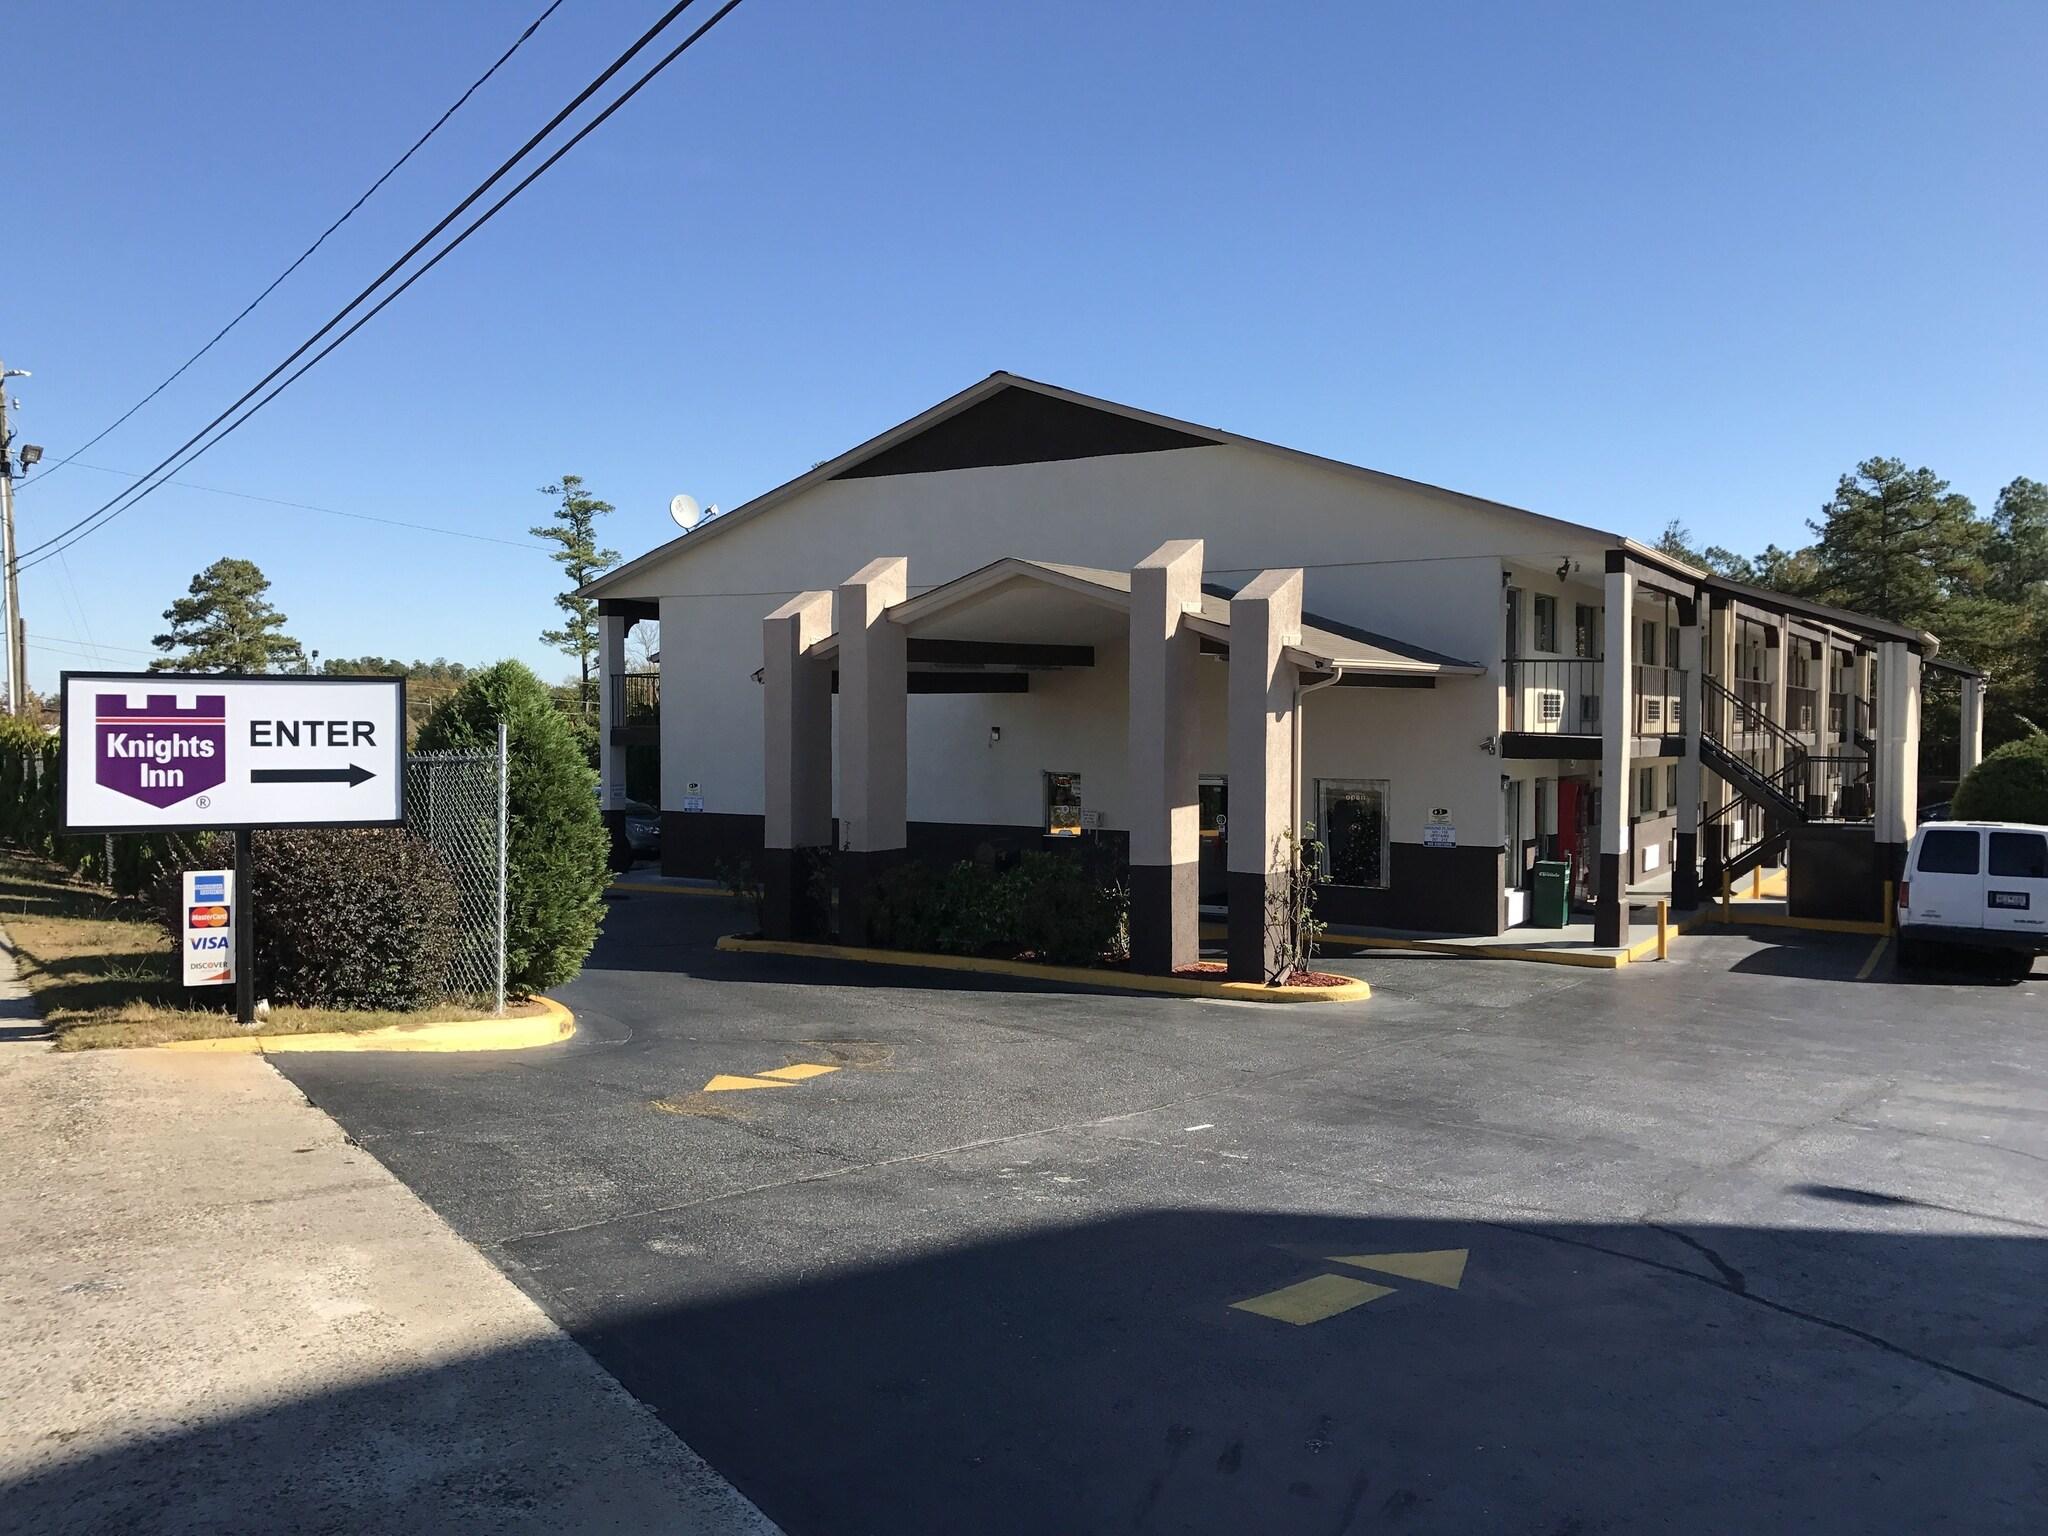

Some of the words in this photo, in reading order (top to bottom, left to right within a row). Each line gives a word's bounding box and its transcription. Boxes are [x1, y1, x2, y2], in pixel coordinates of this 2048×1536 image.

[250, 720, 377, 747] ENTER
[107, 733, 215, 764] Knights
[140, 762, 184, 788] Inn
[191, 937, 229, 950] VISA
[190, 961, 228, 970] DISCOVER
